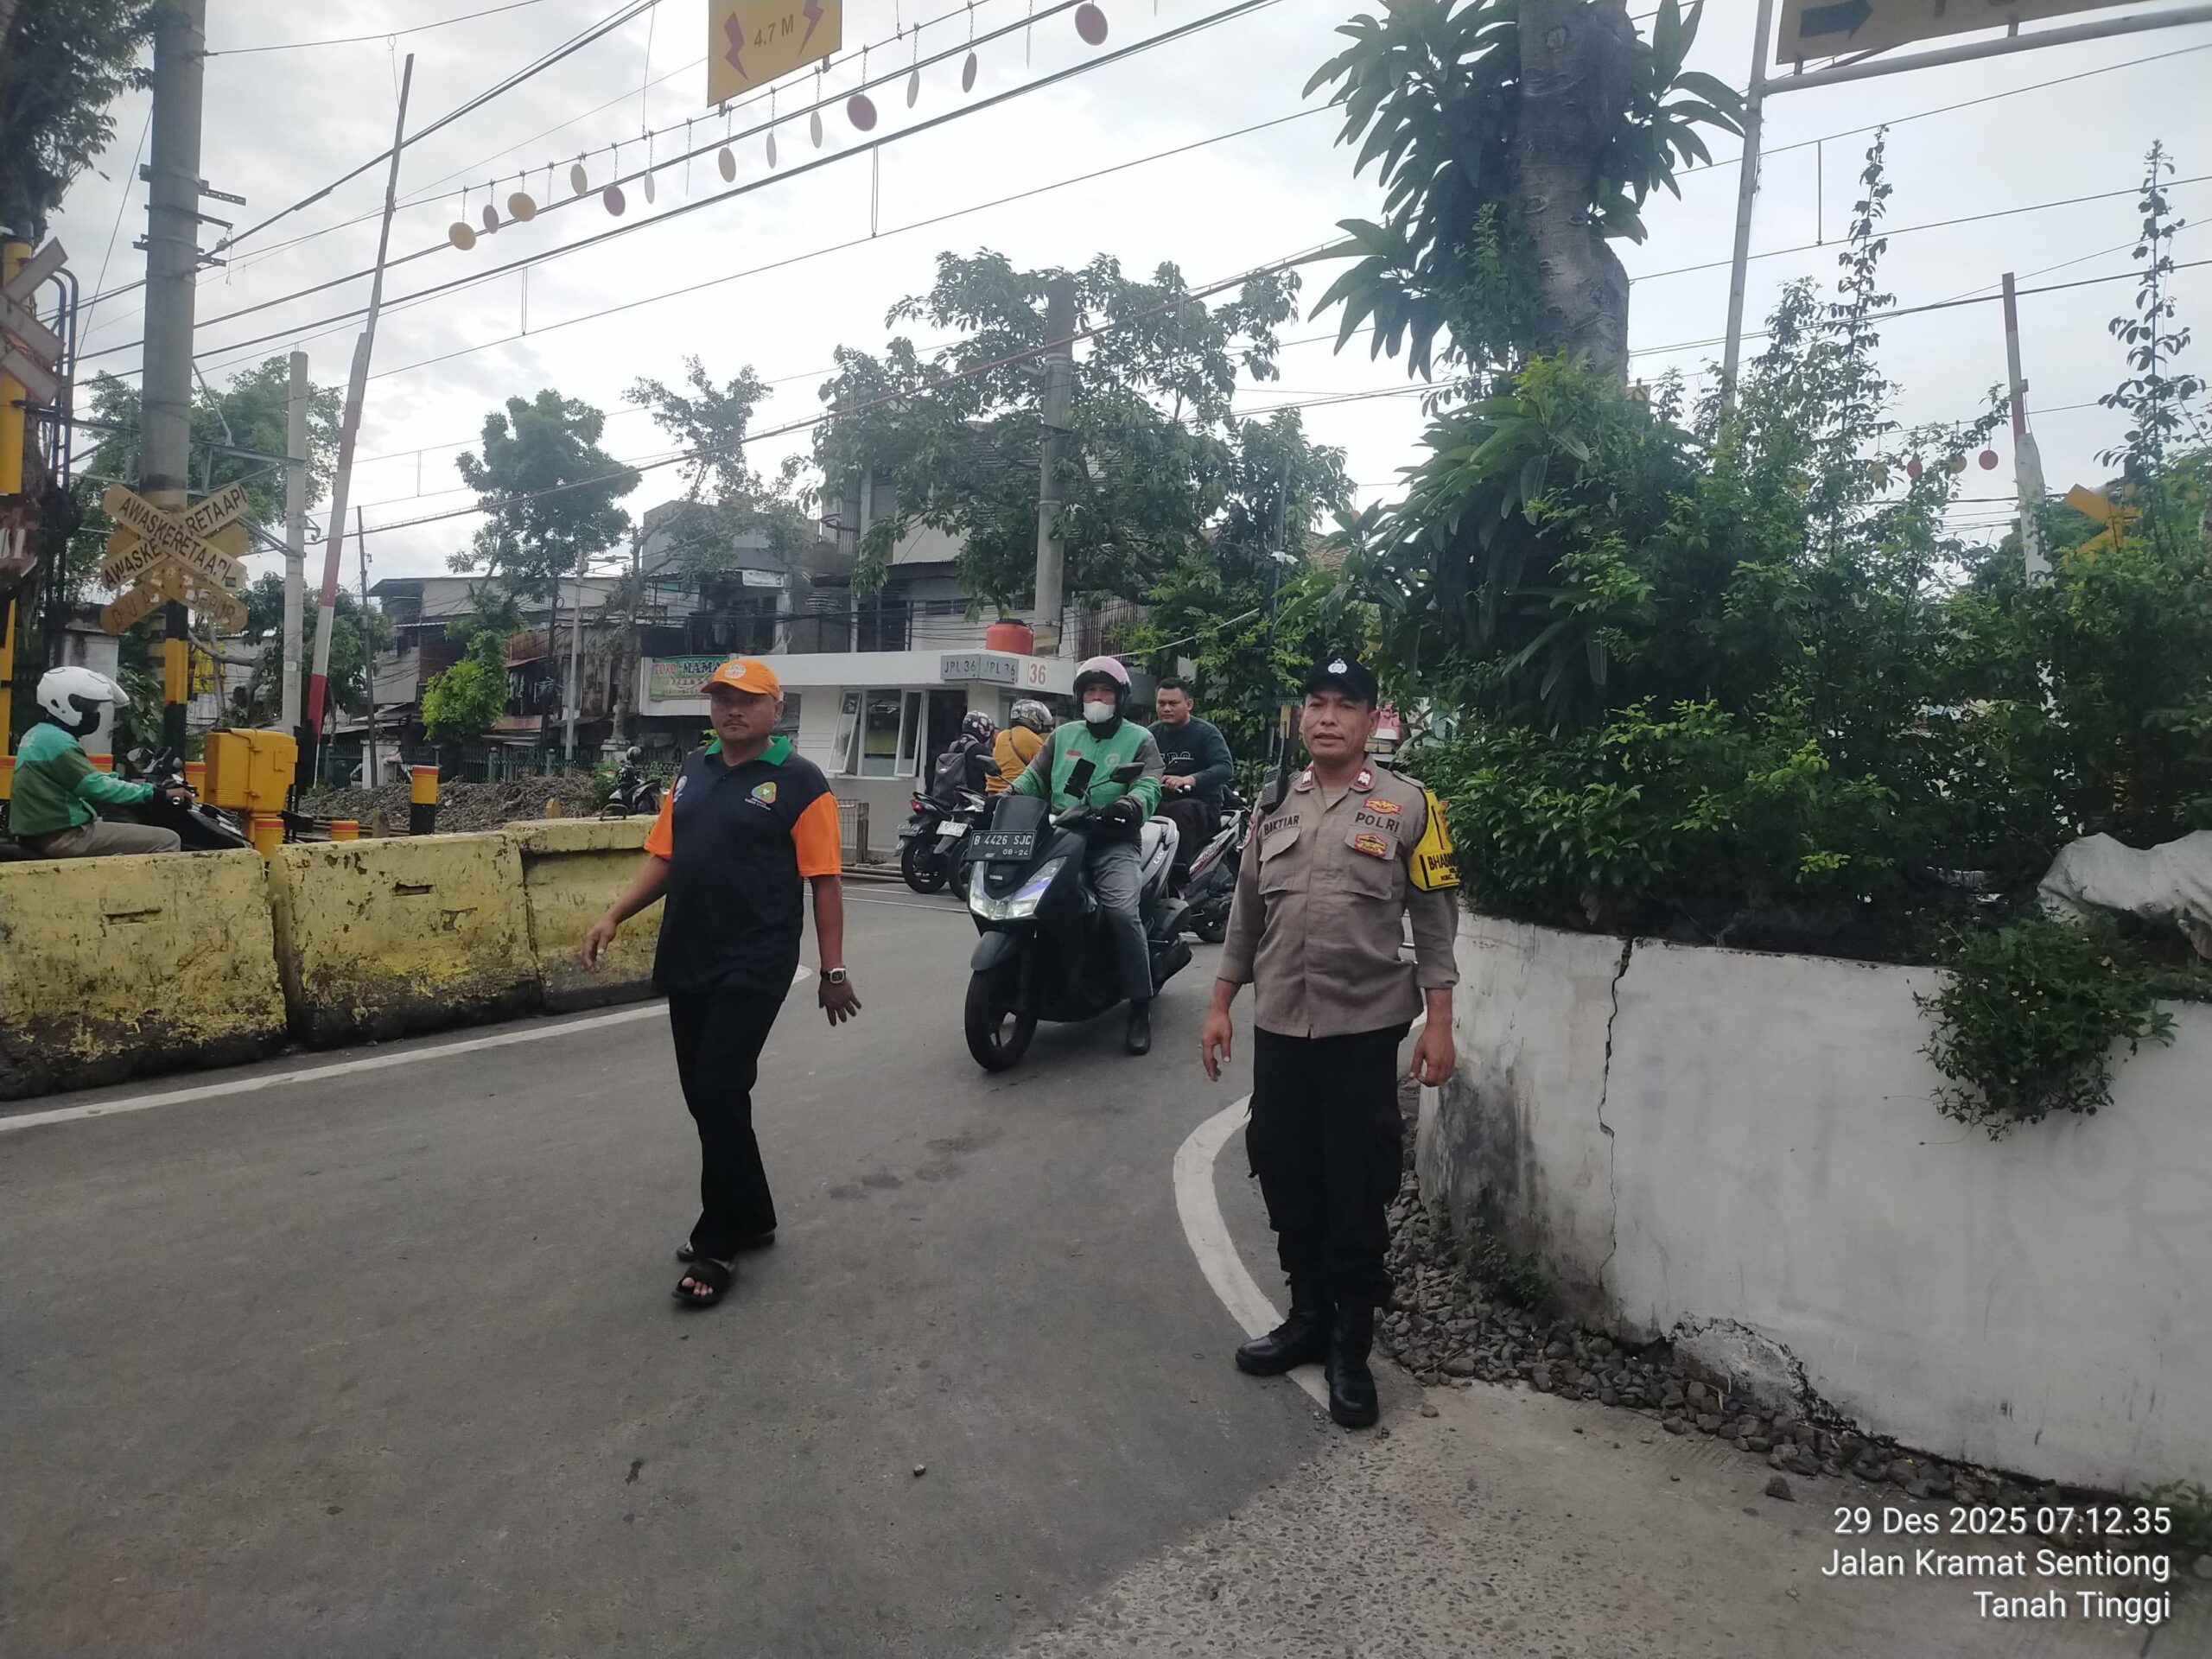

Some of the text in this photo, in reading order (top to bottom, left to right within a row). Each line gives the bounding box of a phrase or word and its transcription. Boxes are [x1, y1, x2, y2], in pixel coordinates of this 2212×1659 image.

[753, 14, 794, 48] 4.7 M
[653, 663, 677, 674] TOKO
[944, 660, 976, 673] JPL 36
[1030, 663, 1046, 685] 36
[1355, 812, 1400, 833] POLRI
[974, 835, 1032, 846] B 4426 SJC
